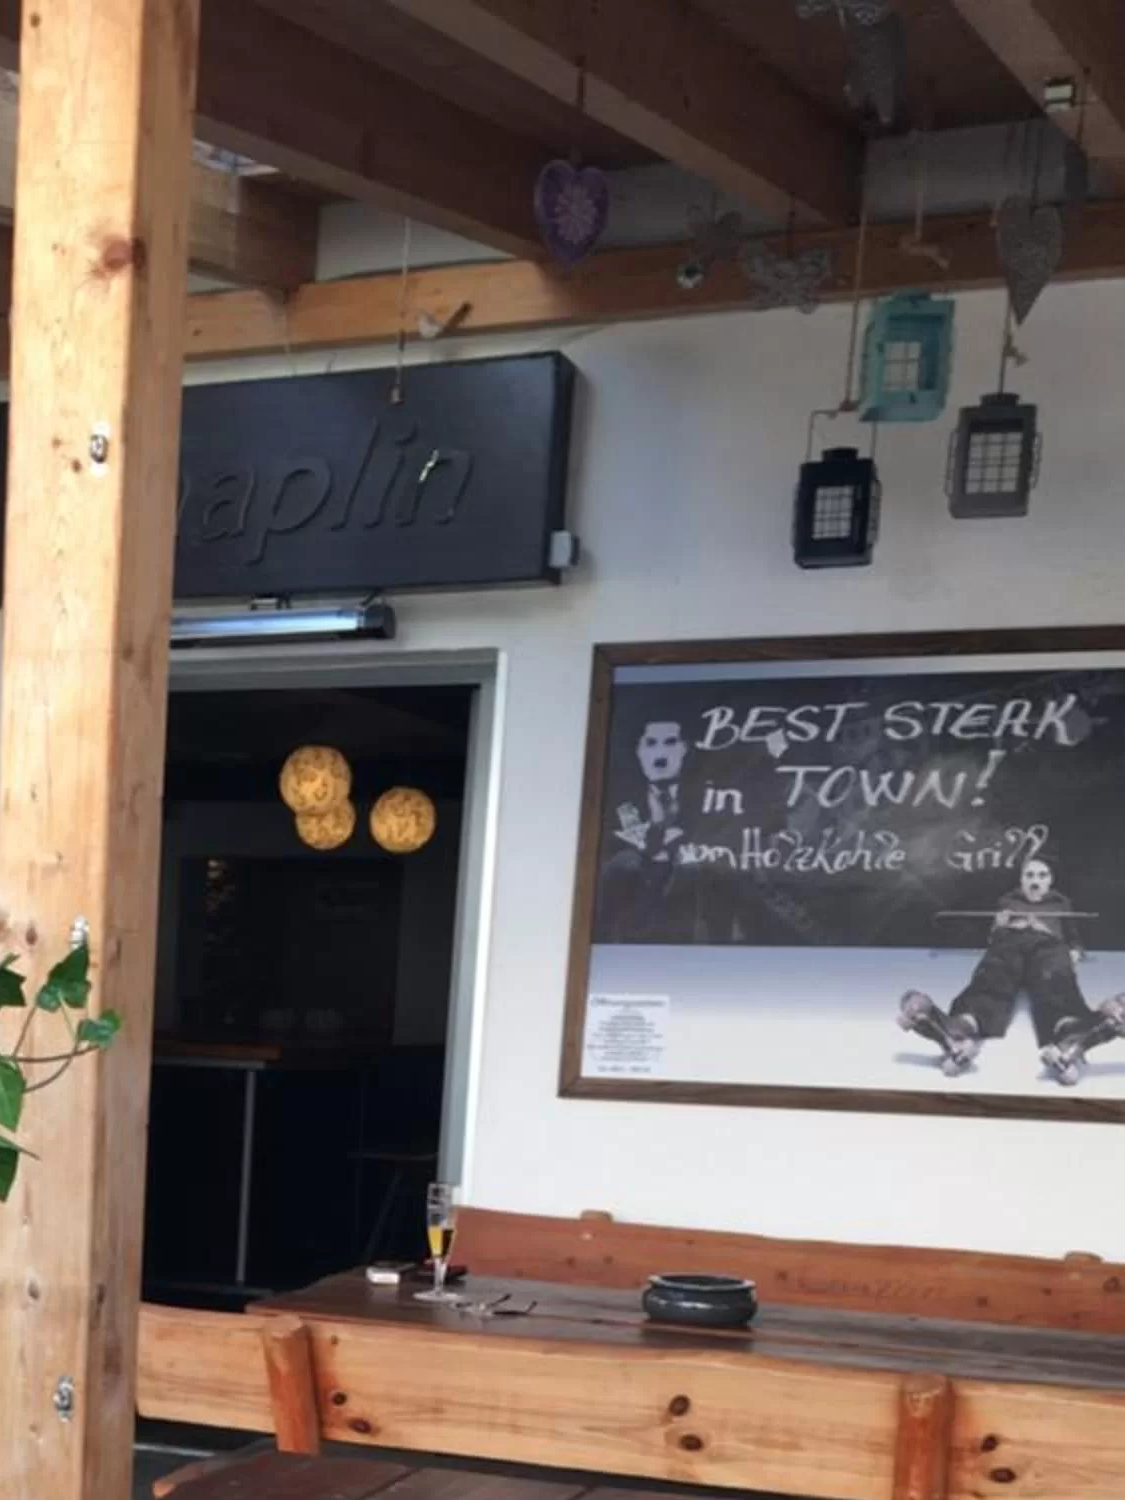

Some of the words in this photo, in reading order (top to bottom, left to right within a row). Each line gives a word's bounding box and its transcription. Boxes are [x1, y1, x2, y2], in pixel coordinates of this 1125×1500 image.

[178, 418, 475, 566] aplin
[695, 704, 869, 750] BEST
[883, 695, 1077, 745] STEAK
[702, 780, 744, 814] in
[776, 749, 1006, 809] TOWN!
